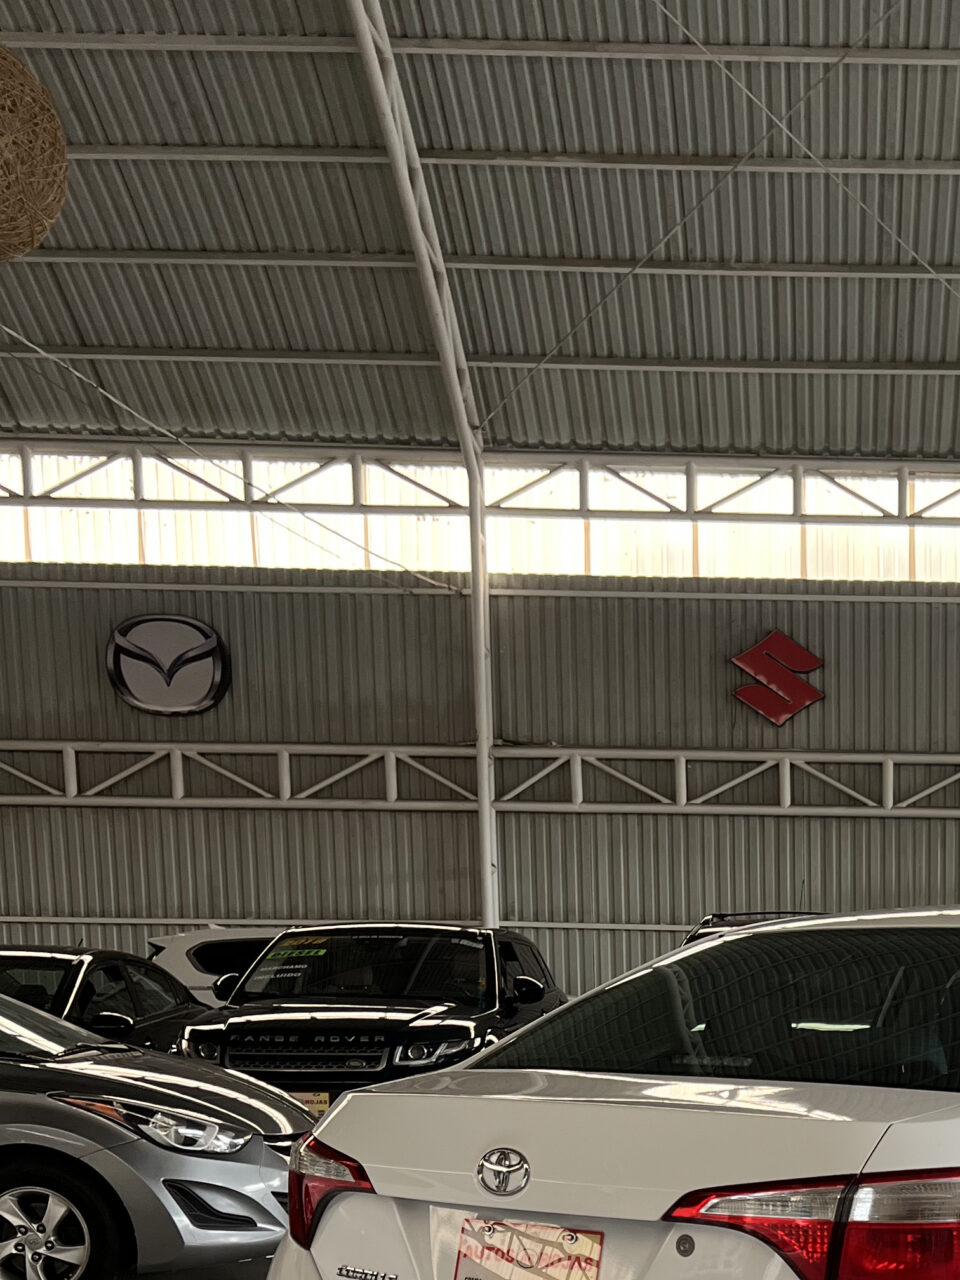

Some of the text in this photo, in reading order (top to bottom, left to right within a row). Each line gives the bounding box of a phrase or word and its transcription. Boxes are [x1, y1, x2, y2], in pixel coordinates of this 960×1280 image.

[230, 1035, 386, 1043] RANGE ROVER
[462, 1245, 594, 1273] AUTOS ROJAS
